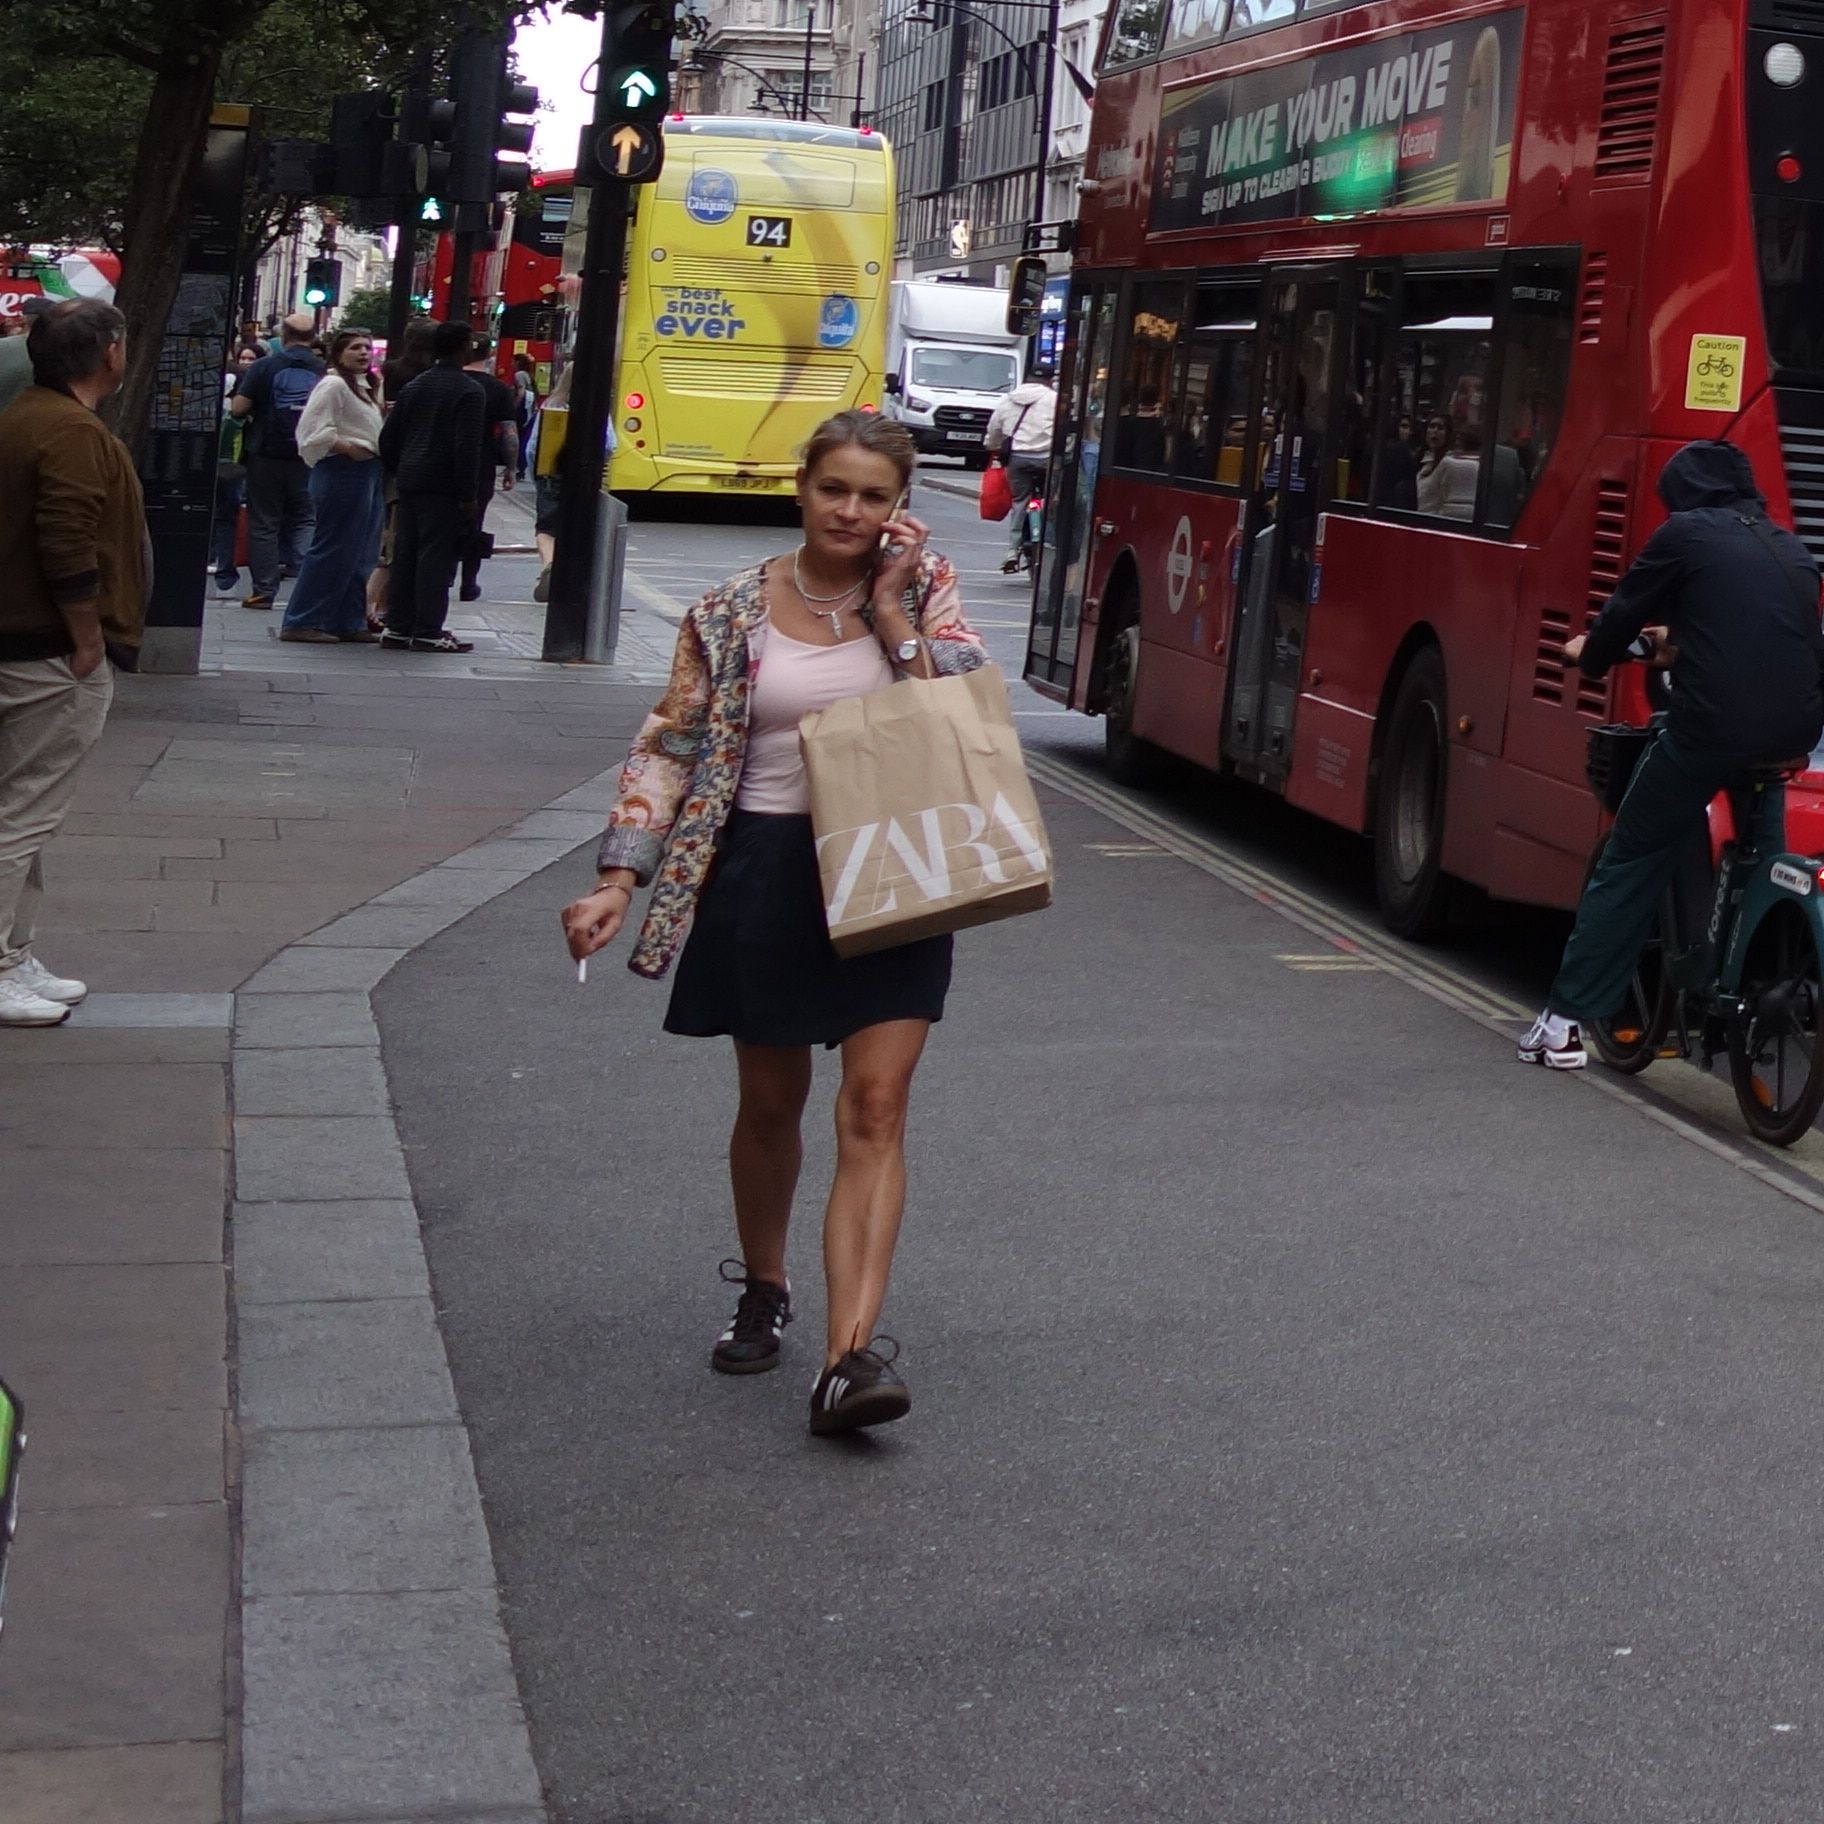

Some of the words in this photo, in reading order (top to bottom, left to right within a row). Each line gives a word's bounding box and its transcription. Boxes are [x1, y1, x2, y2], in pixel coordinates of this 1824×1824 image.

[1205, 103, 1280, 179] MAKE
[1284, 75, 1357, 154] YOUR
[1360, 40, 1454, 130] MOVE
[751, 218, 787, 246] 94
[680, 286, 722, 301] best
[666, 299, 735, 317] snack
[655, 314, 746, 340] ever
[1697, 339, 1739, 351] Caution
[814, 790, 1048, 927] ZARA
